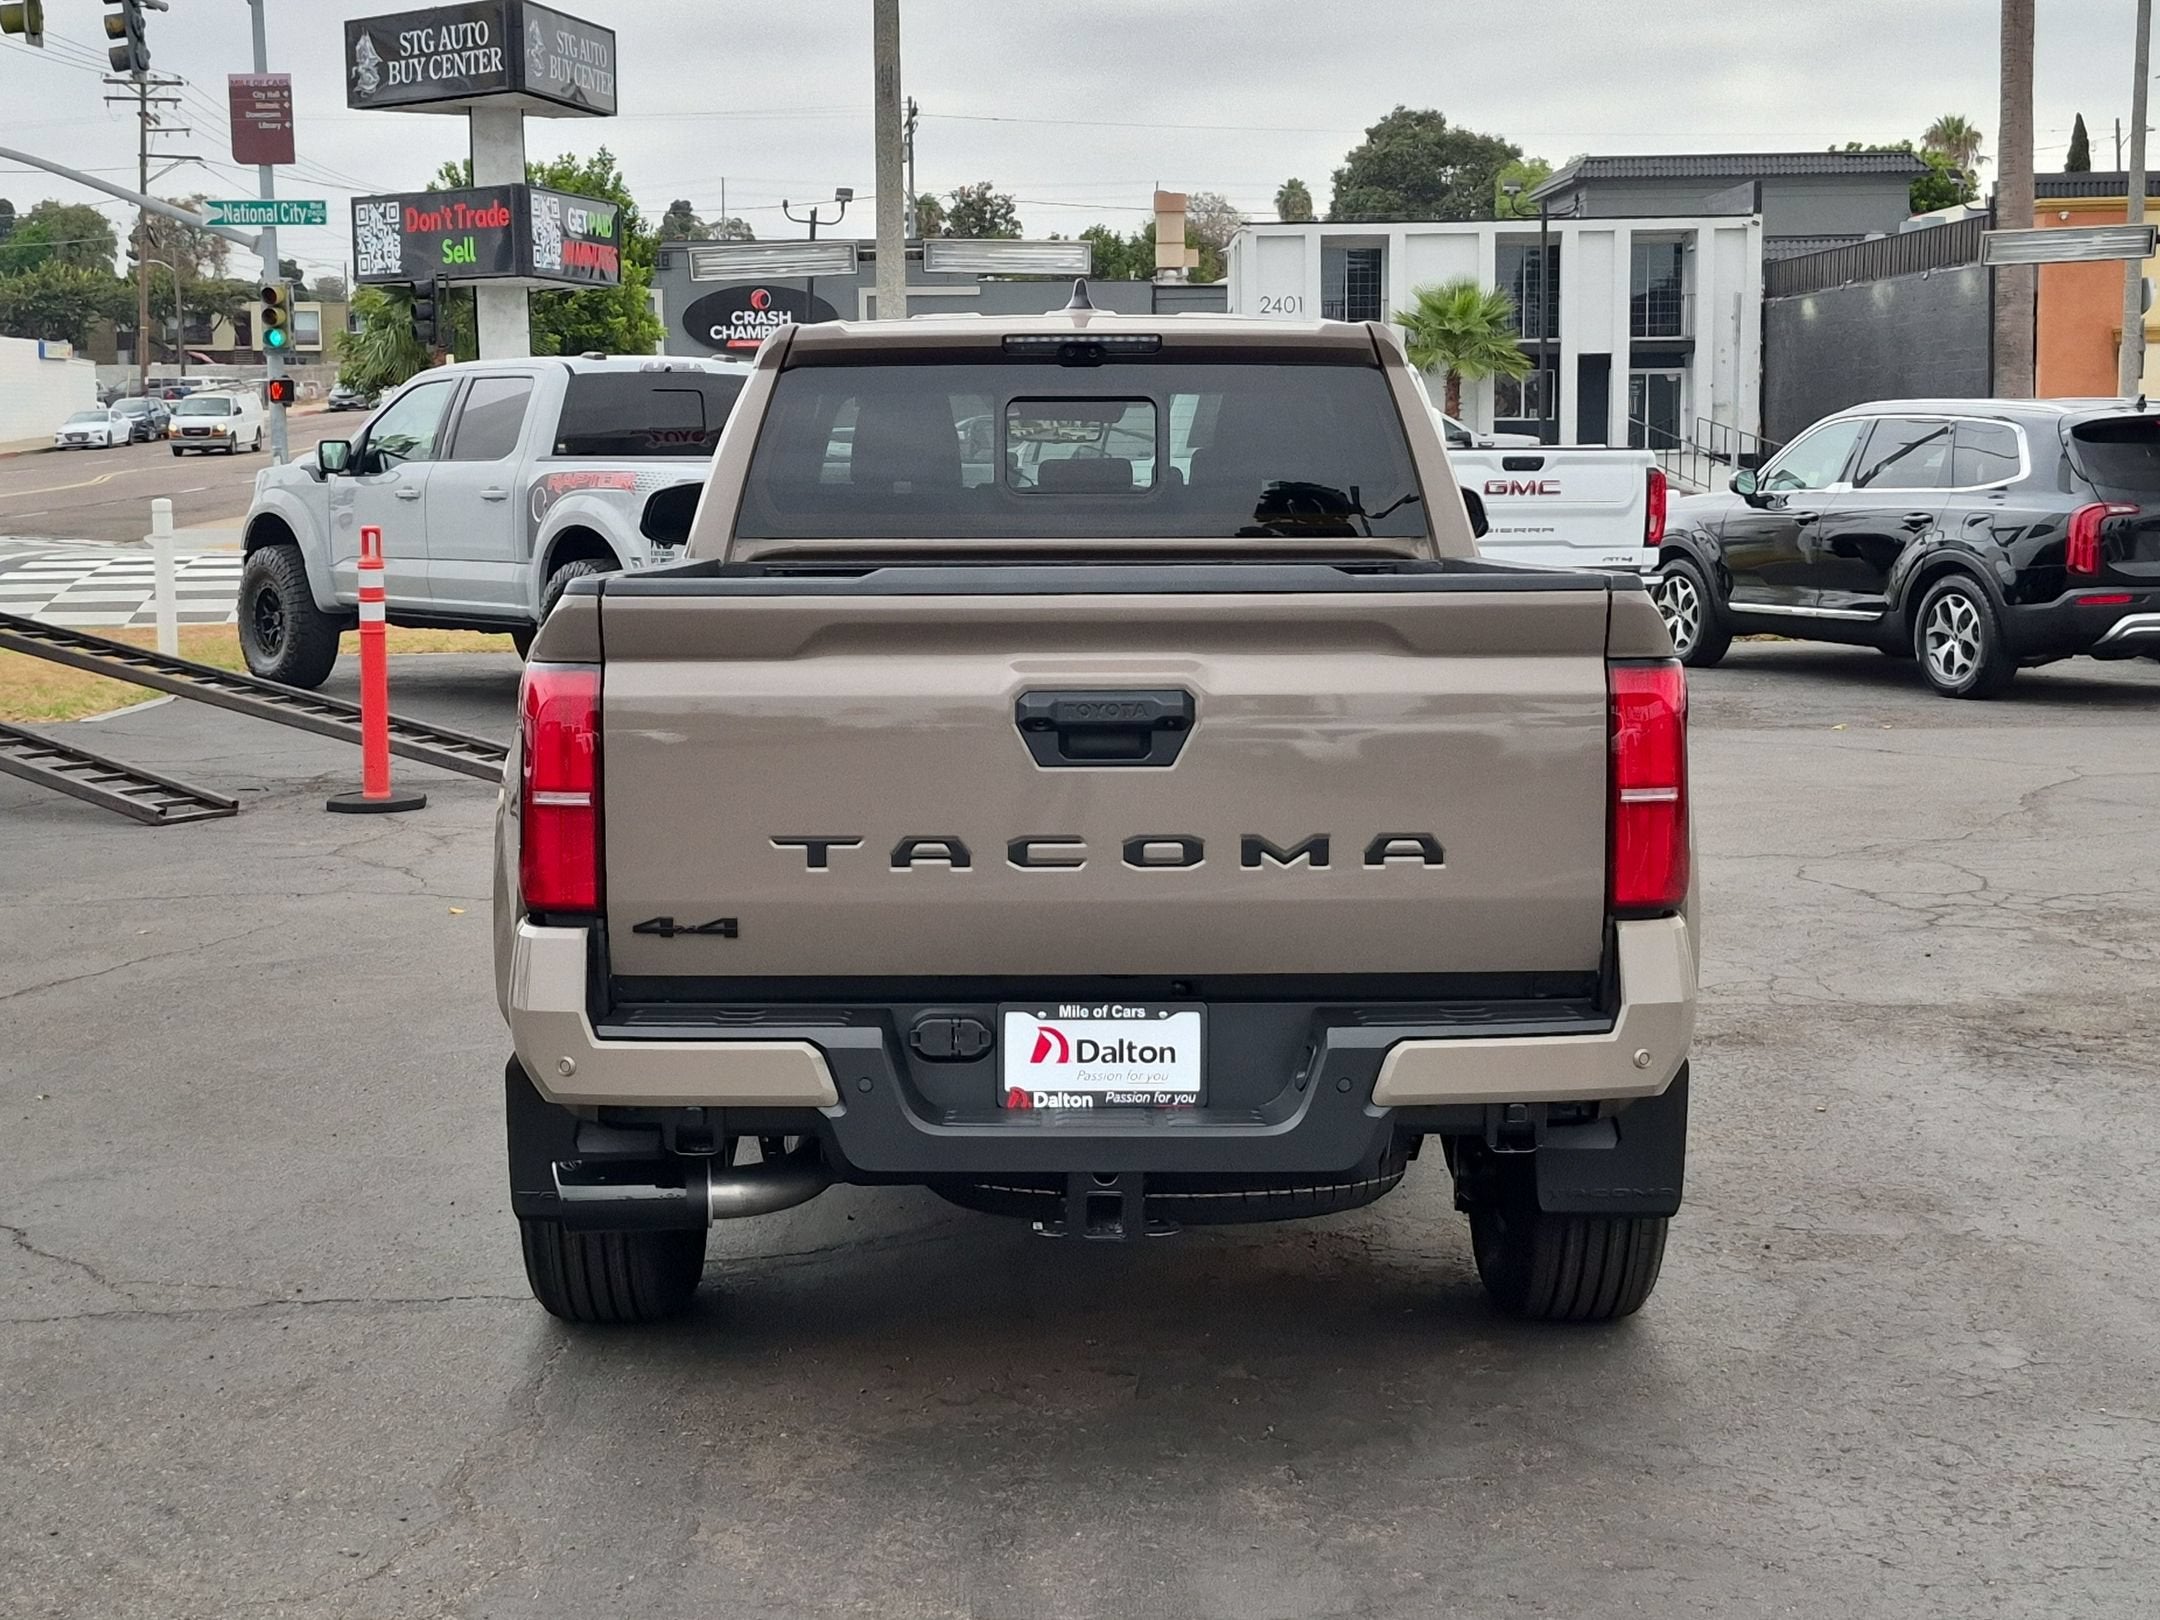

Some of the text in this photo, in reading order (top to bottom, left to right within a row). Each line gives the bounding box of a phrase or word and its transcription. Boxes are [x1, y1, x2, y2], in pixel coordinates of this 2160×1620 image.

[400, 20, 489, 57] STG AUTO
[557, 30, 607, 68] STG AUTO
[388, 47, 504, 86] BUY CENTER
[550, 55, 614, 97] BUY CENTER
[223, 202, 307, 225] National City
[405, 199, 510, 233] Don't Trade
[567, 207, 588, 235] GET
[442, 236, 477, 264] Sell
[1259, 295, 1303, 314] 2401
[731, 310, 792, 325] CRASH
[710, 325, 778, 340] CHAMP
[548, 470, 637, 493] RAPTOR
[1484, 480, 1562, 496] GMC
[1064, 703, 1149, 718] TOYOTA
[769, 833, 1448, 872] TACOMA
[1059, 1004, 1146, 1019] Mile of Cars
[1076, 1038, 1176, 1064] Dalton
[1076, 1070, 1169, 1083] Passion for you
[1033, 1092, 1094, 1109] Dalton
[1105, 1092, 1197, 1106] Passion for you
